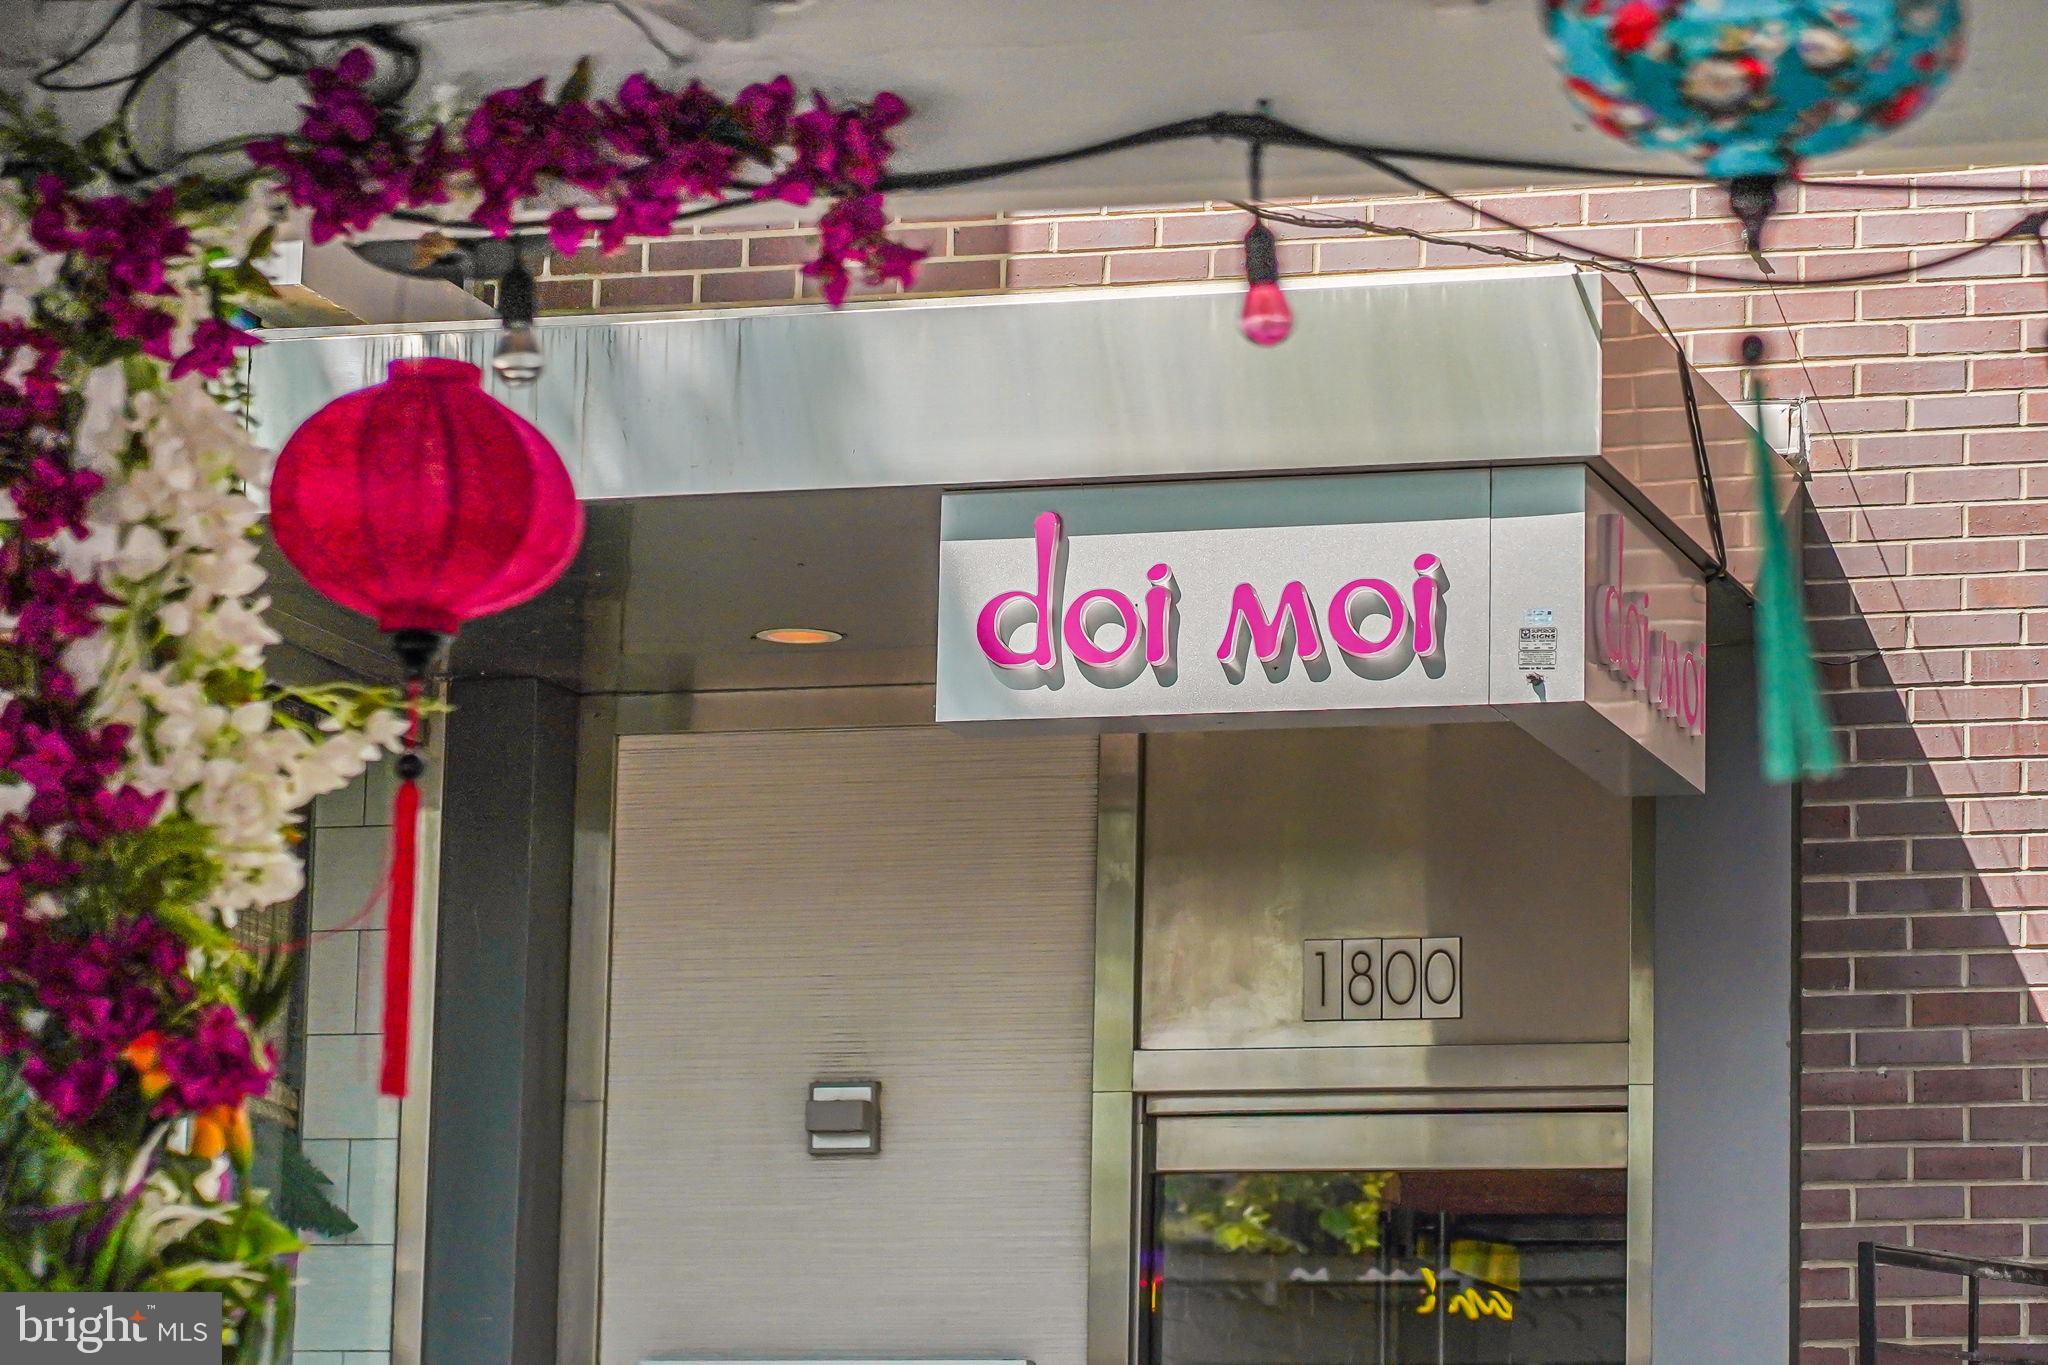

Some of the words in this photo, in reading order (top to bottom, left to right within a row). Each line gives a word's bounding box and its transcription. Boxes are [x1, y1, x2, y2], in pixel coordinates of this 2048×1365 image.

[976, 511, 1173, 671] doi
[1603, 512, 1649, 690] doi
[1315, 949, 1456, 1007] 1800
